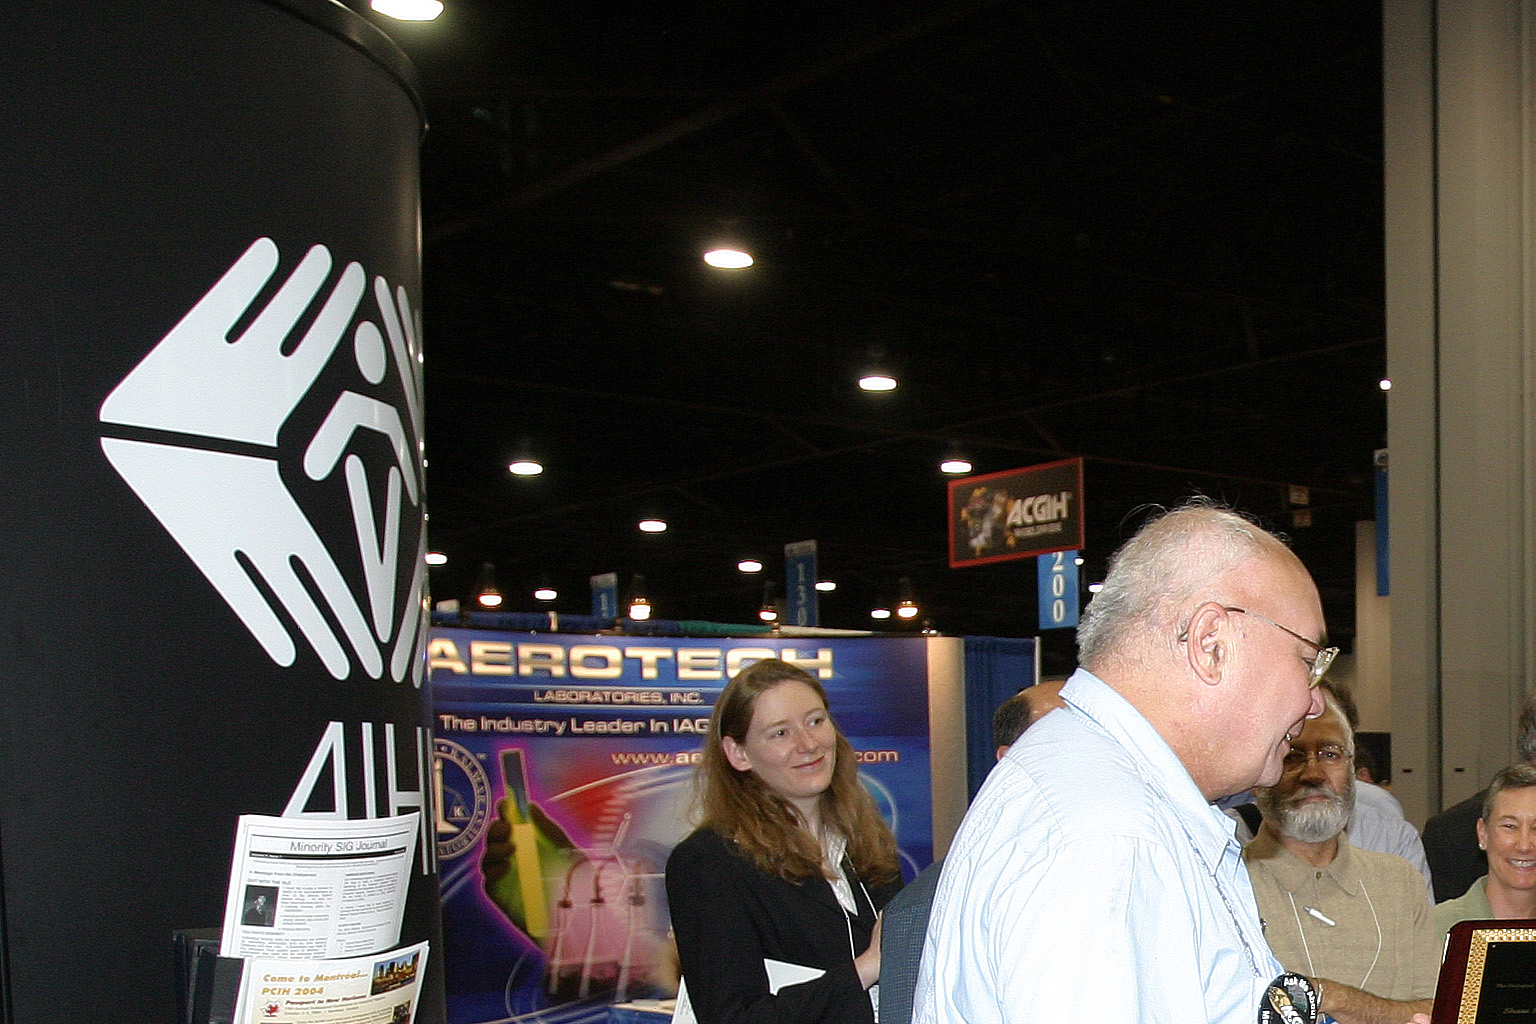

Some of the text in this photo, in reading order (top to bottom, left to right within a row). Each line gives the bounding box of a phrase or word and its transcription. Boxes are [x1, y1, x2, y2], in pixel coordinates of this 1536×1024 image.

[1006, 491, 1069, 526] ACGIH
[429, 638, 833, 680] AEROTECH
[439, 714, 476, 732] The
[481, 716, 567, 735] Industry
[571, 717, 646, 734] Leader
[650, 719, 670, 732] In
[290, 839, 388, 854] Minority SIG Journal
[263, 974, 295, 983] Come
[299, 974, 310, 982] to
[261, 986, 325, 995] PCIH 2004
